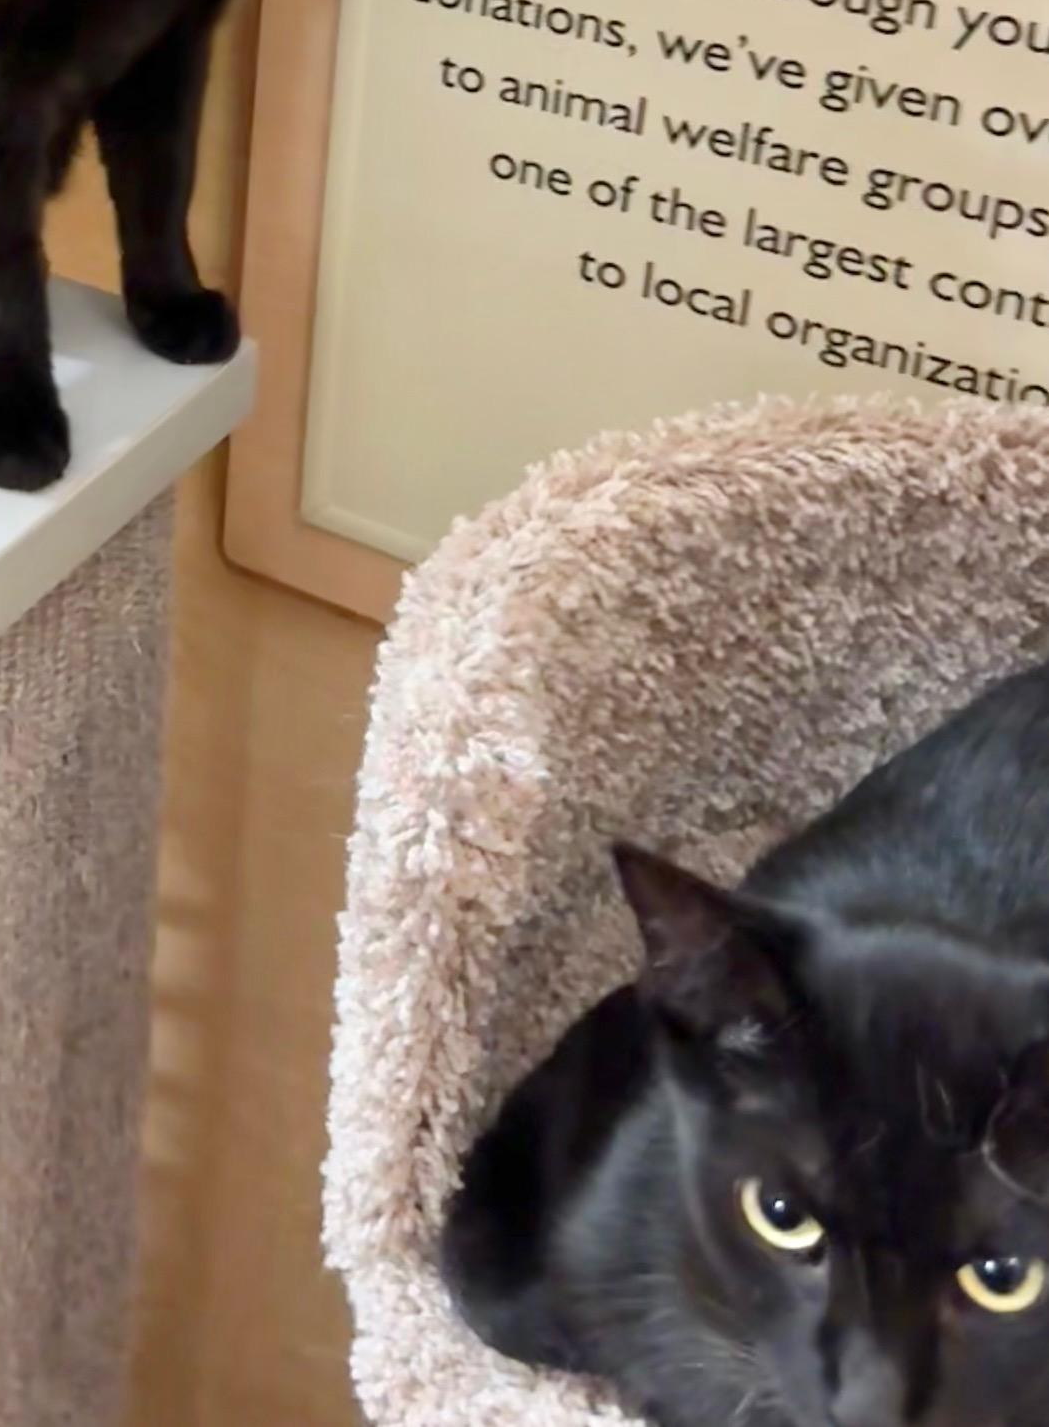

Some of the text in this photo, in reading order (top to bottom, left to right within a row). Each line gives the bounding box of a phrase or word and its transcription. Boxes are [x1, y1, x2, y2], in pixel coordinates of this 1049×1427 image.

[657, 31, 807, 89] we've
[819, 65, 961, 126] given
[981, 106, 1049, 143] ov
[952, 7, 1049, 55] you
[440, 58, 1049, 239] to animal welfare groups
[490, 153, 1049, 327] one of the largest cont
[579, 252, 626, 289] to
[642, 262, 751, 327] local
